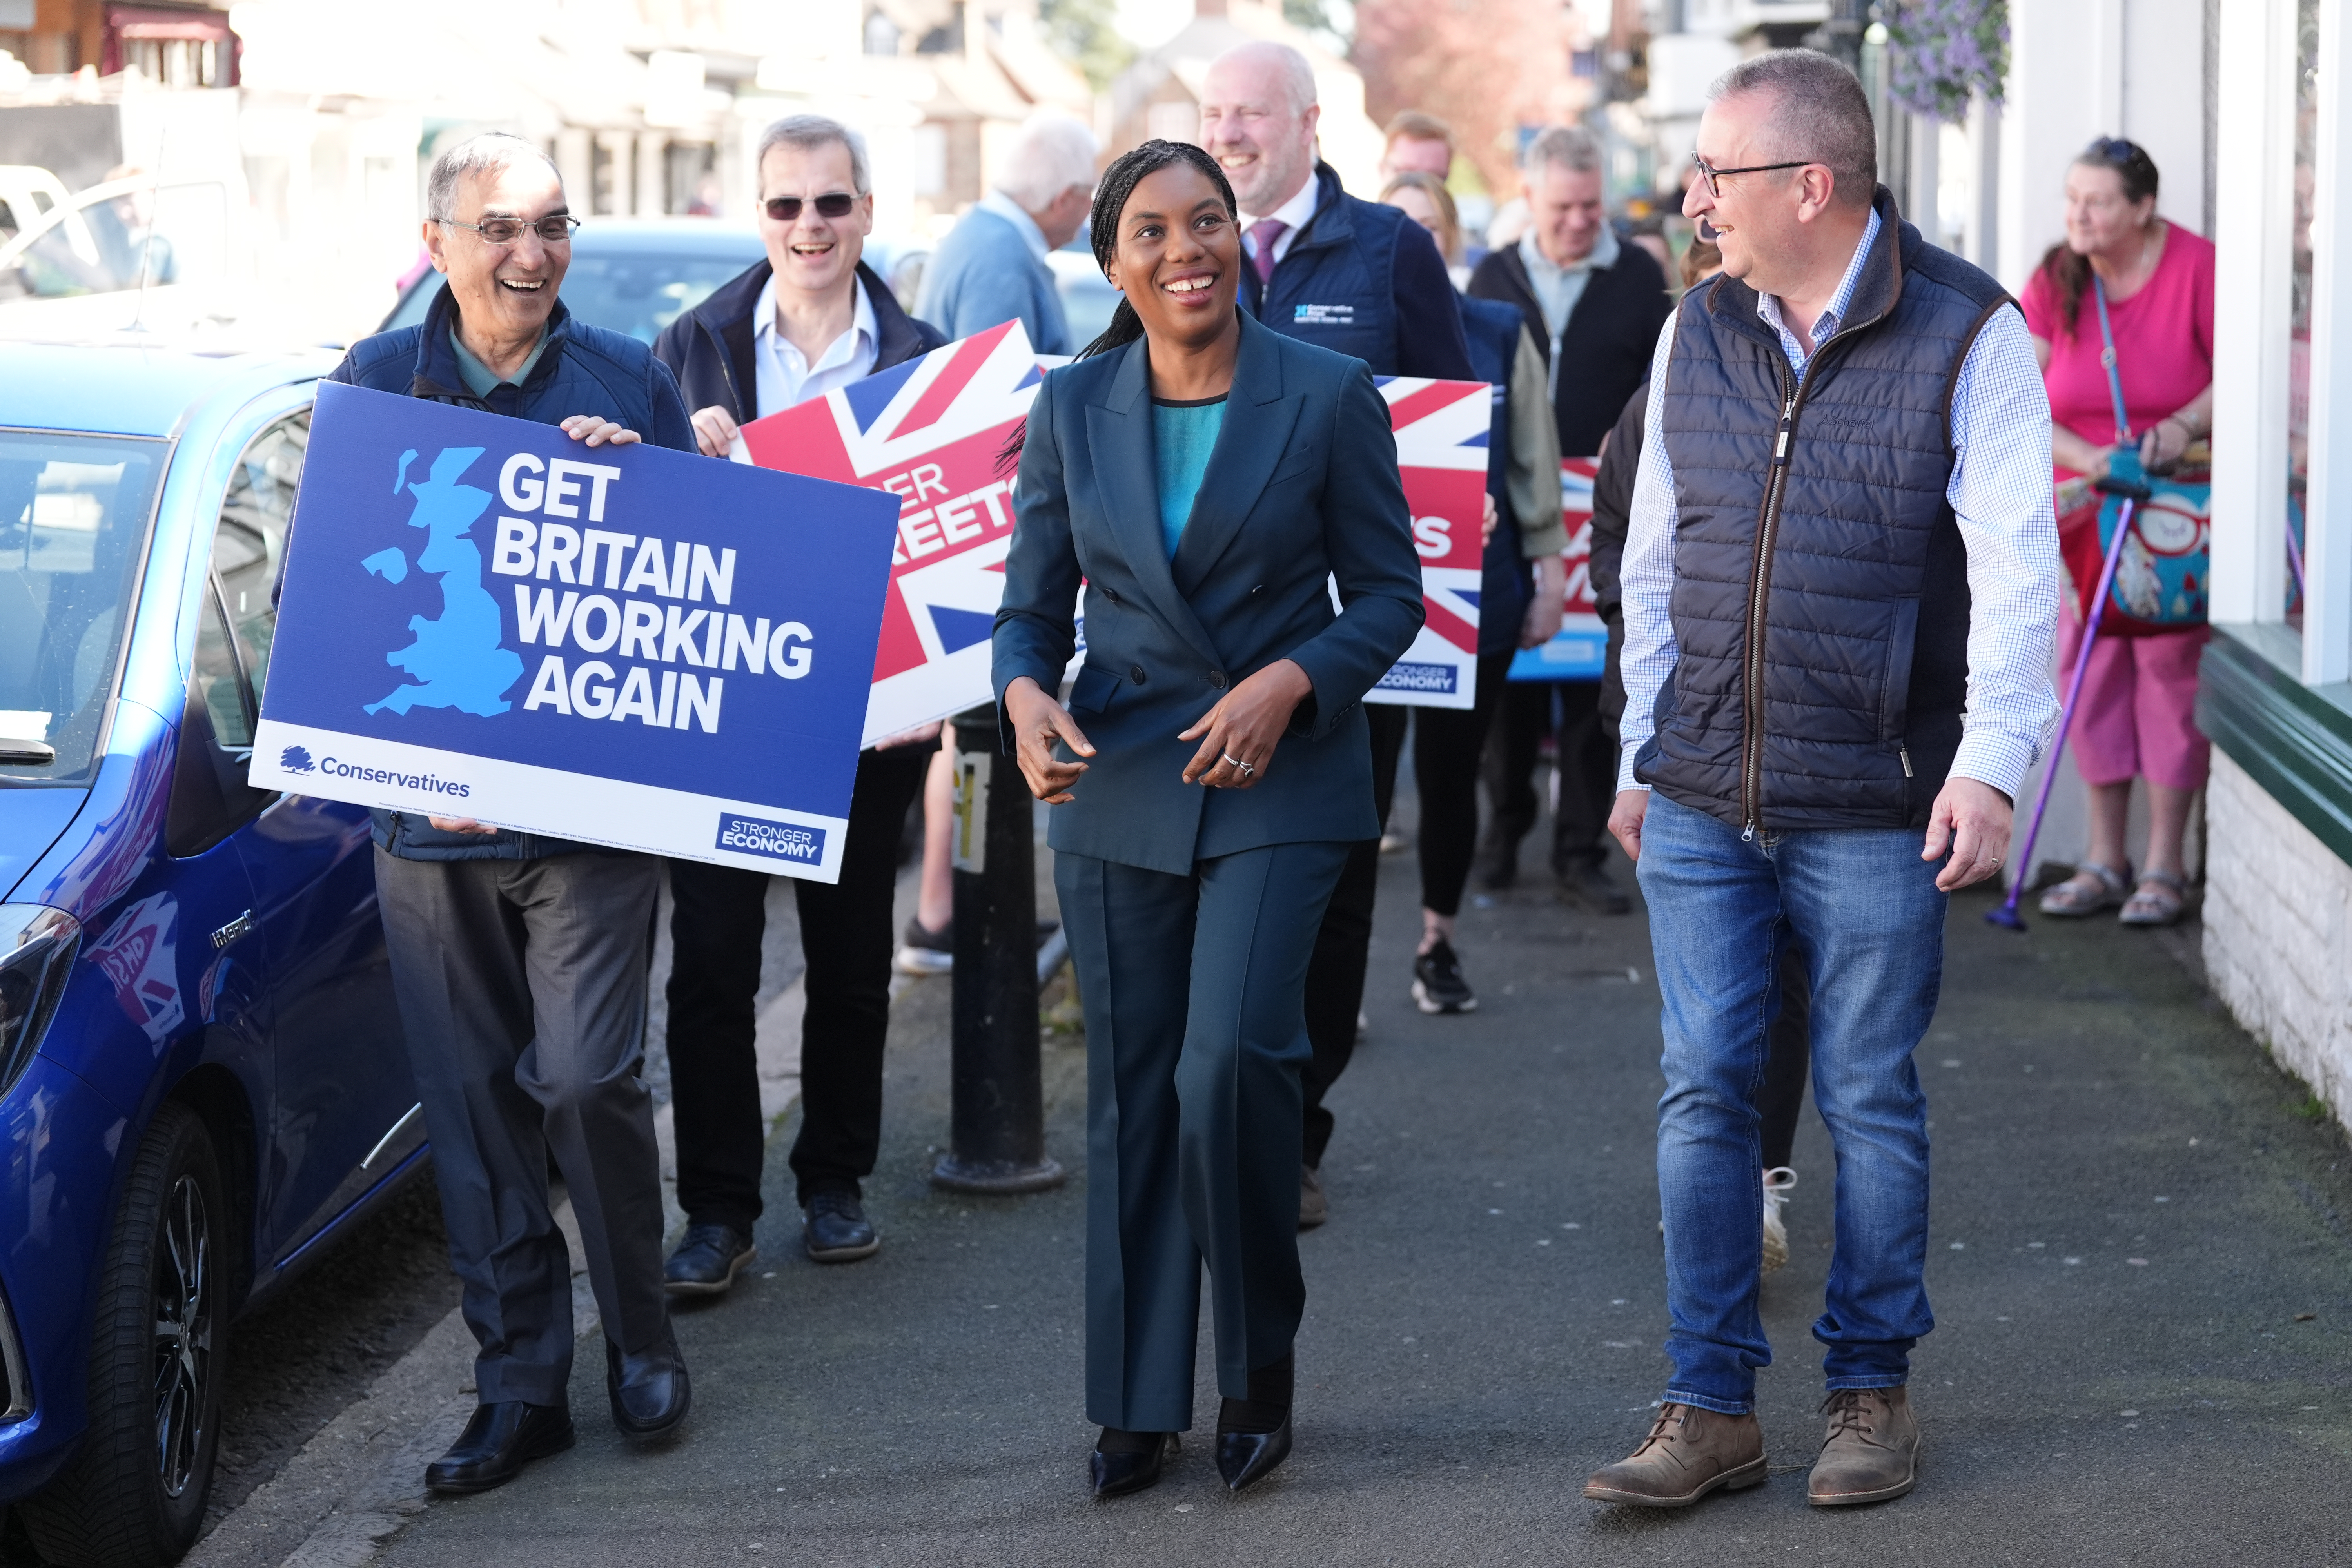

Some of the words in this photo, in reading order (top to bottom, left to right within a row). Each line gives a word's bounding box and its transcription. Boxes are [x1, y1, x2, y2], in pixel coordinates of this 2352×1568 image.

[499, 452, 621, 522] GET
[866, 463, 949, 511] ER
[491, 516, 736, 605] BRITAIN
[514, 584, 813, 680] WORKING
[523, 655, 724, 734] AGAIN
[1375, 674, 1453, 691] CONOMY
[321, 757, 470, 797] Conservatives
[722, 831, 817, 858] ECONOMY
[731, 820, 811, 844] STRONGER
